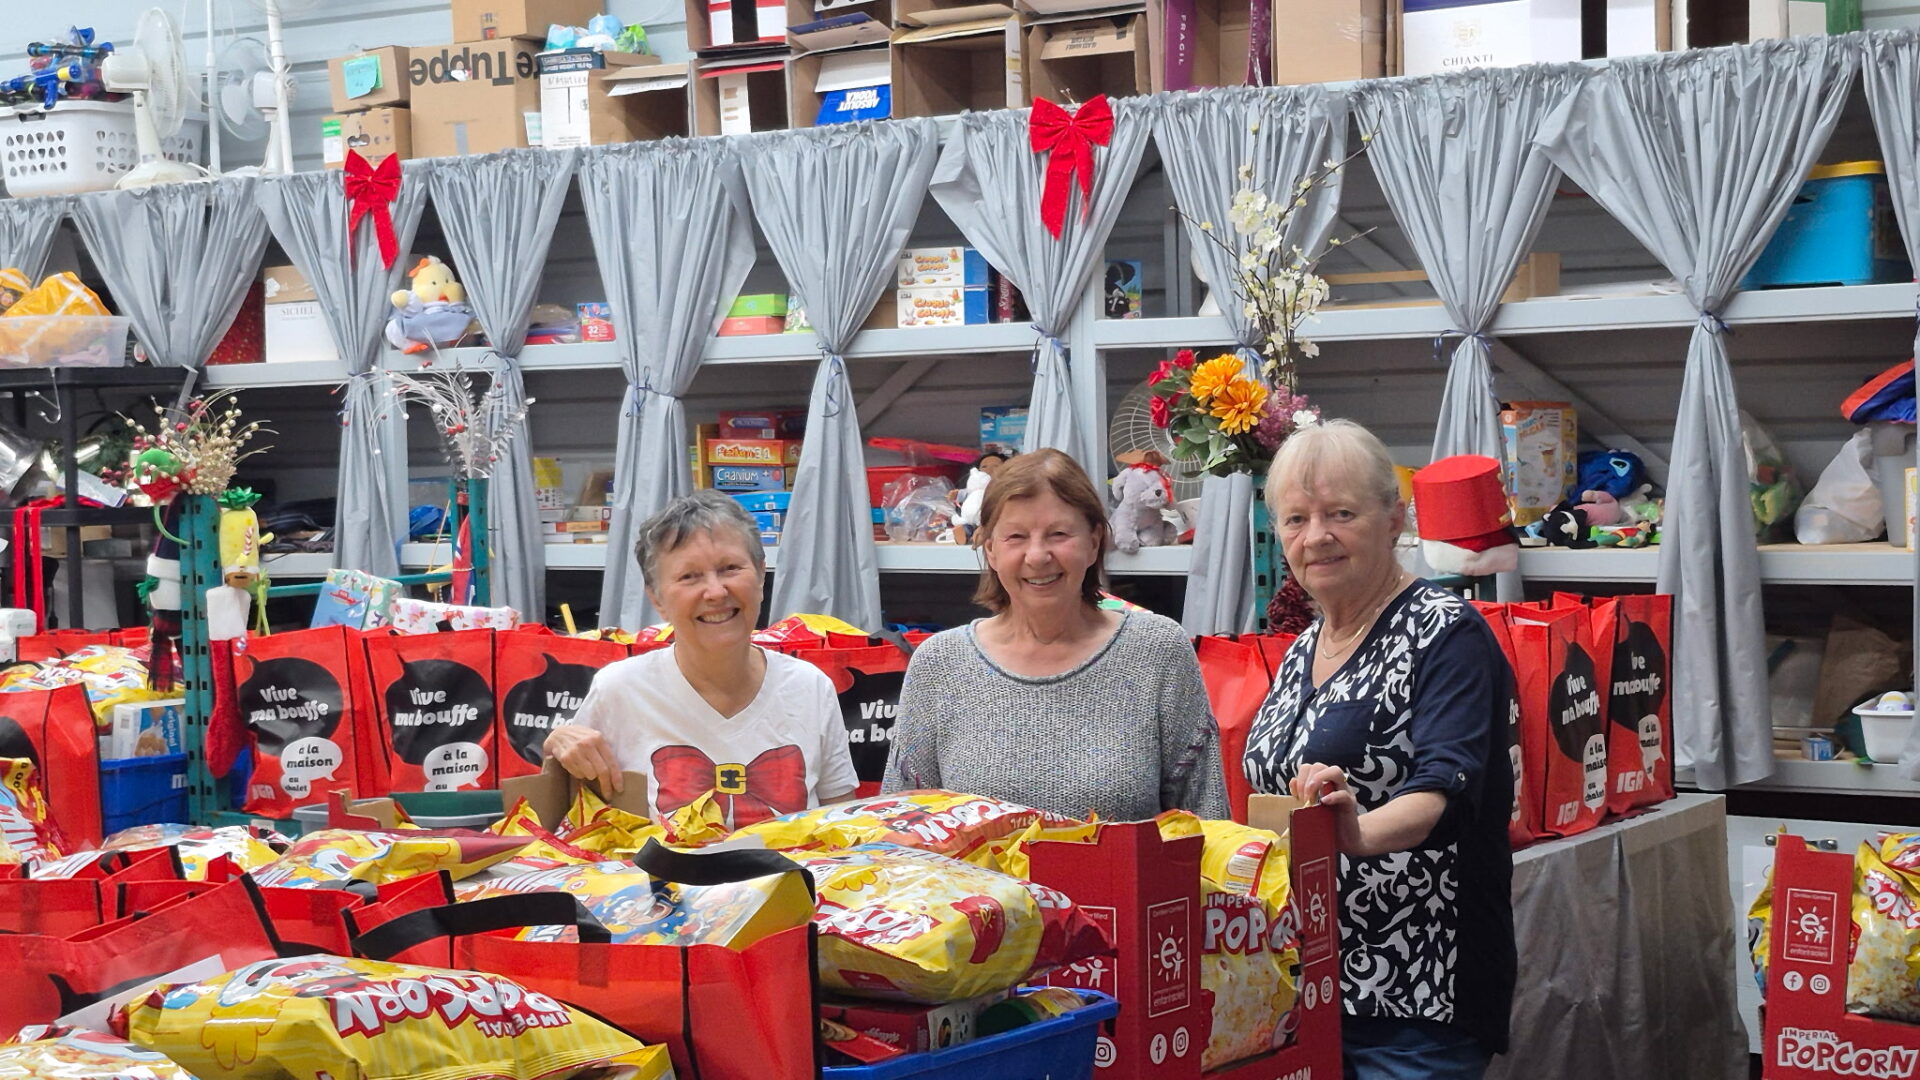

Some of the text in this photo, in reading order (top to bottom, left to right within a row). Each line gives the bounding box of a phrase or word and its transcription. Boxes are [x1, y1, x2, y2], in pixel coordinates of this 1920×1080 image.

[1443, 54, 1493, 66] CHIANTI
[845, 89, 878, 101] VODKA
[836, 98, 881, 112] ABSOLUT
[260, 685, 298, 702] Vive
[546, 690, 583, 711] Viv
[249, 700, 329, 725] ma bouffe
[860, 699, 899, 720] Viv
[514, 712, 549, 729] ma
[307, 743, 319, 754] la
[443, 749, 468, 761] à la
[286, 756, 334, 769] maison
[432, 762, 479, 776] maison
[1616, 771, 1645, 793] IGA
[1556, 801, 1580, 827] IGA
[1783, 1028, 1838, 1042] IMPERIAL
[1779, 1036, 1917, 1077] POPCORN
